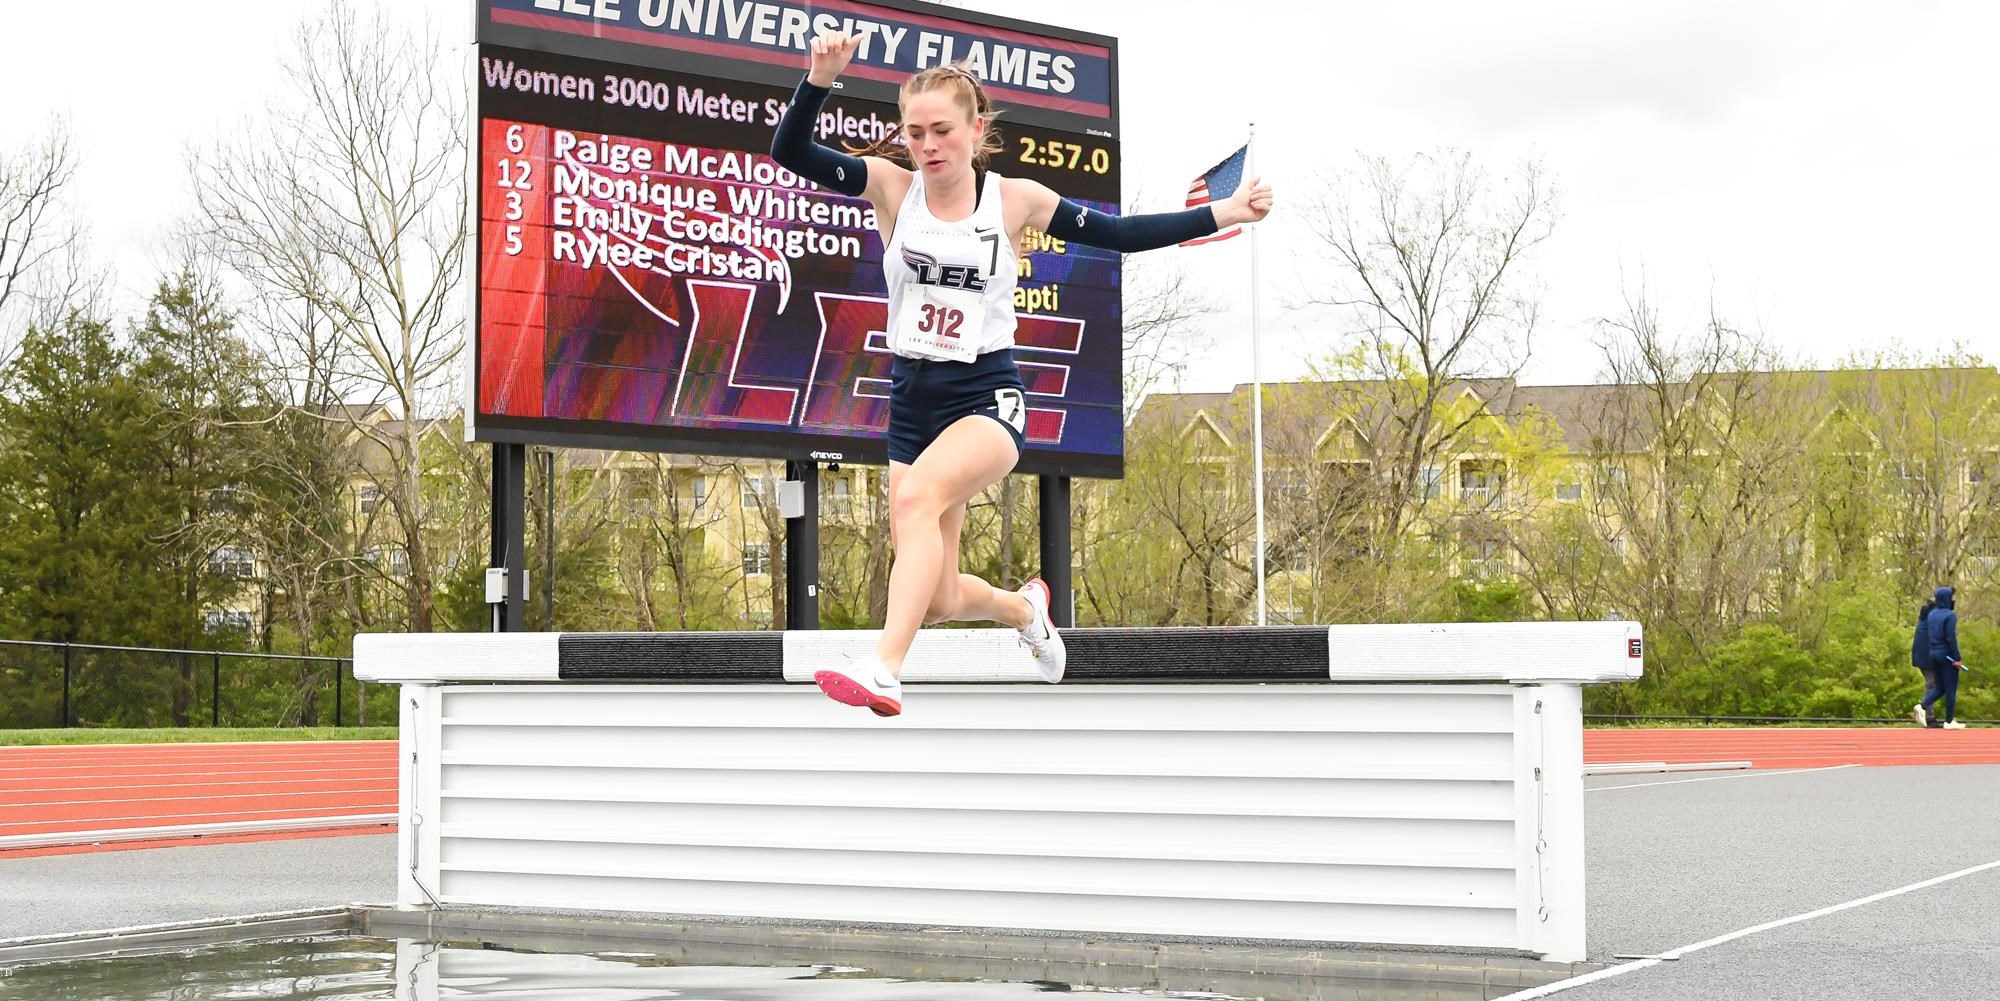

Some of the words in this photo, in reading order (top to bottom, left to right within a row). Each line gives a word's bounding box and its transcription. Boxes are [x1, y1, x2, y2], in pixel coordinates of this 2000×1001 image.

[917, 32, 1076, 94] FLAMES
[482, 57, 595, 101] Women
[602, 75, 670, 111] 3000
[676, 86, 759, 125] Meter
[505, 125, 525, 154] 6
[1020, 136, 1110, 175] 2:57.0
[497, 158, 533, 191] 12
[554, 165, 717, 212] Monique
[728, 185, 879, 232] Whitema
[505, 191, 523, 220] 3
[554, 198, 653, 242] Emily
[663, 210, 861, 259] Coddington
[505, 226, 523, 255] 5
[554, 231, 653, 270] Rylee
[664, 243, 786, 283] Cristan
[980, 234, 998, 276] 7
[916, 263, 988, 293] LEE
[918, 304, 964, 338] 312
[1002, 391, 1021, 423] 7
